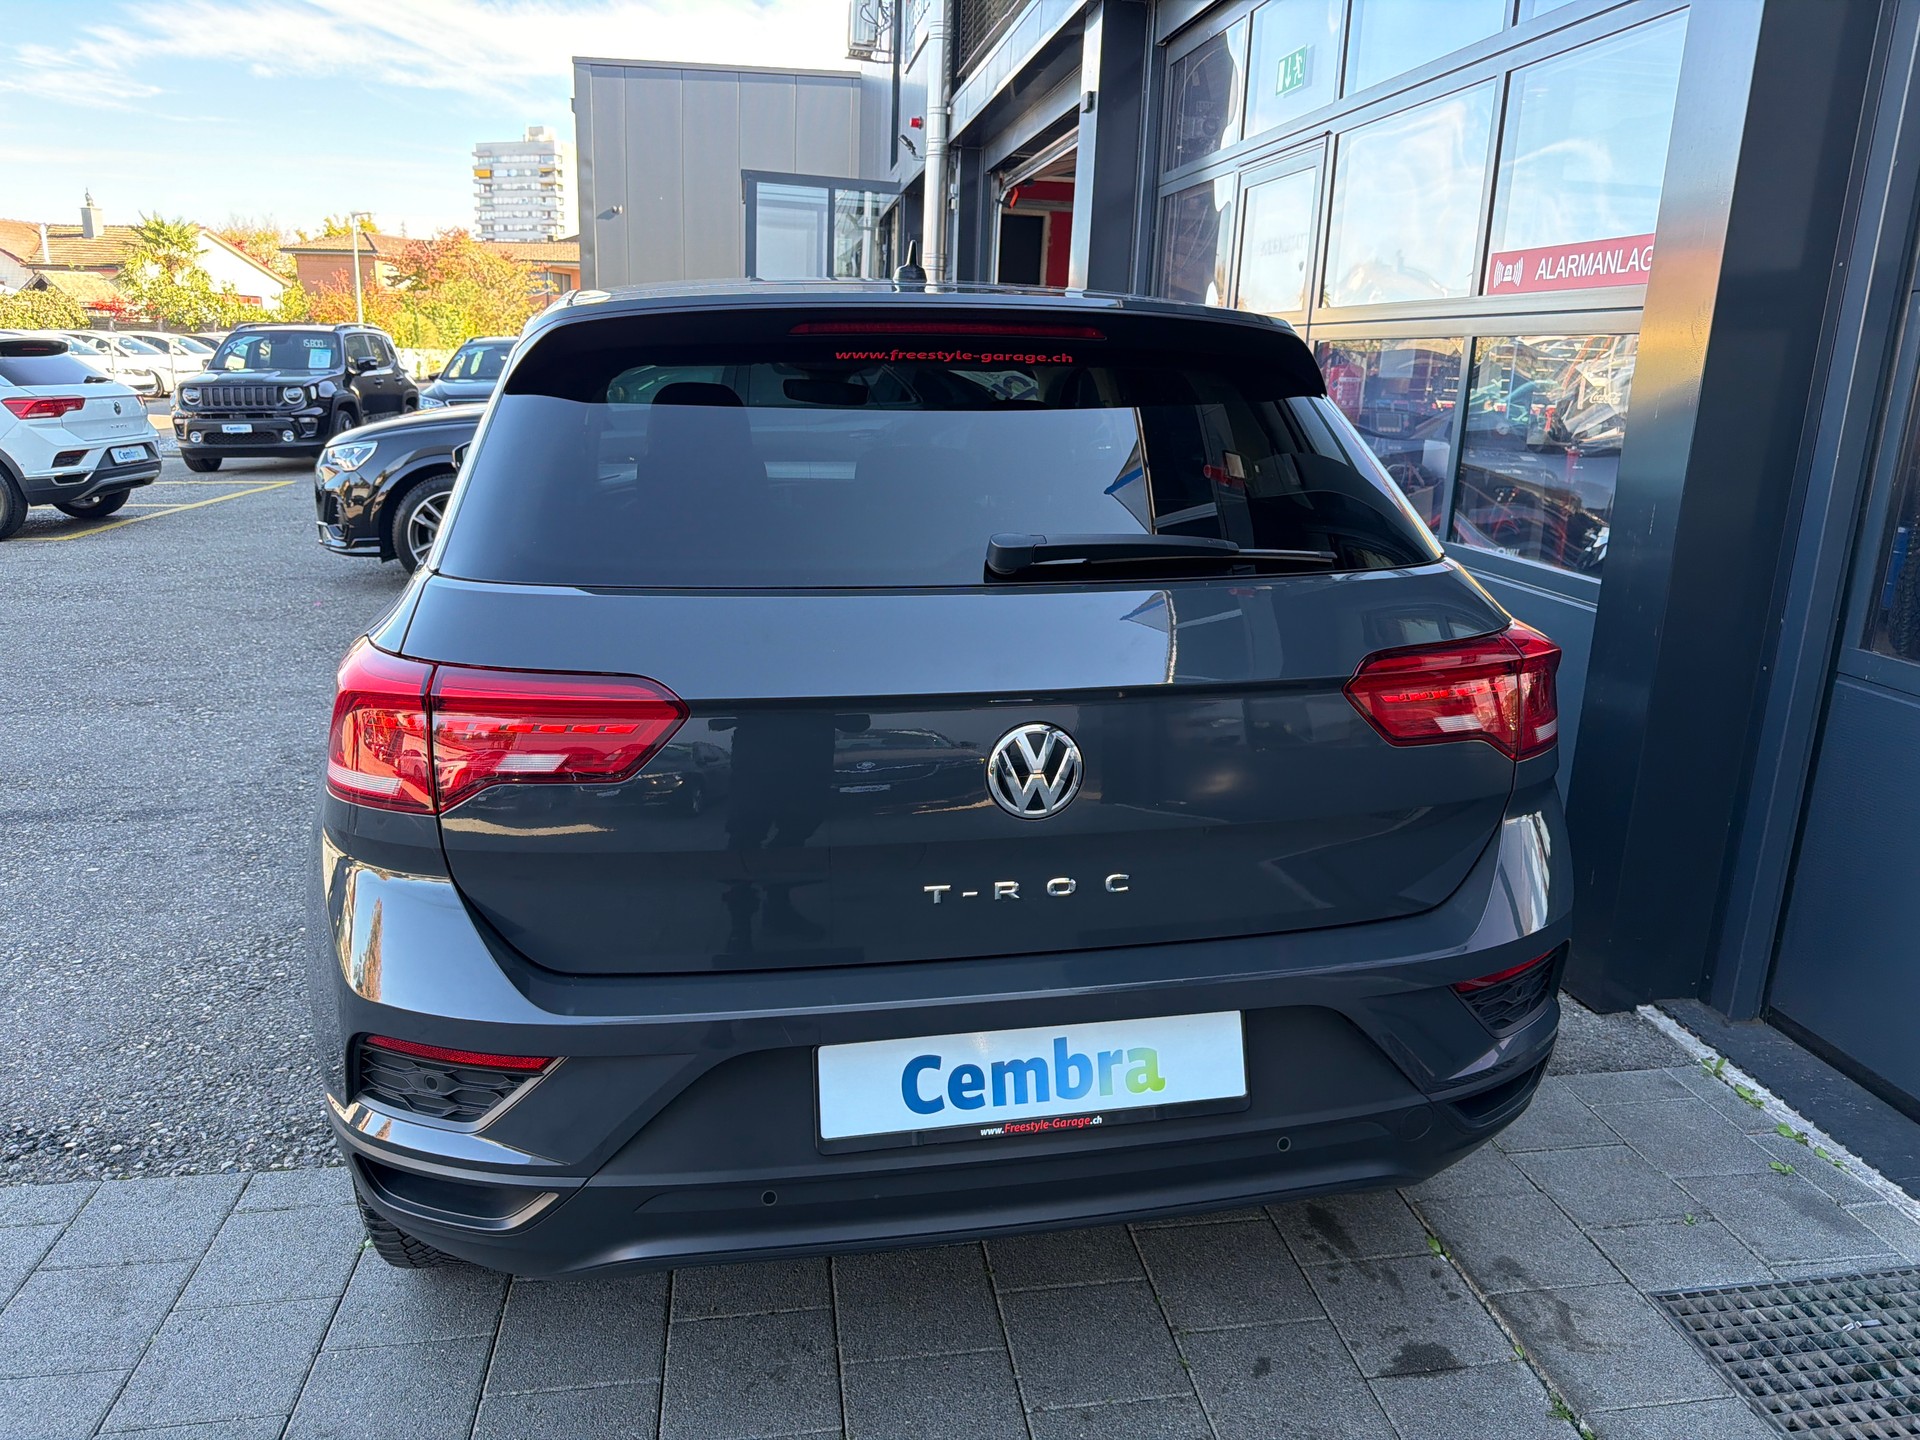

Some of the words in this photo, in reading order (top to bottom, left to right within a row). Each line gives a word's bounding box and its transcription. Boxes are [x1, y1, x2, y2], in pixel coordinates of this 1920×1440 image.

[835, 350, 1073, 363] www.freestyle-garage.ch
[991, 726, 1079, 816] VW
[901, 1036, 1166, 1115] Cembra
[980, 1115, 1103, 1136] www.Freestyle-Garage.ch
